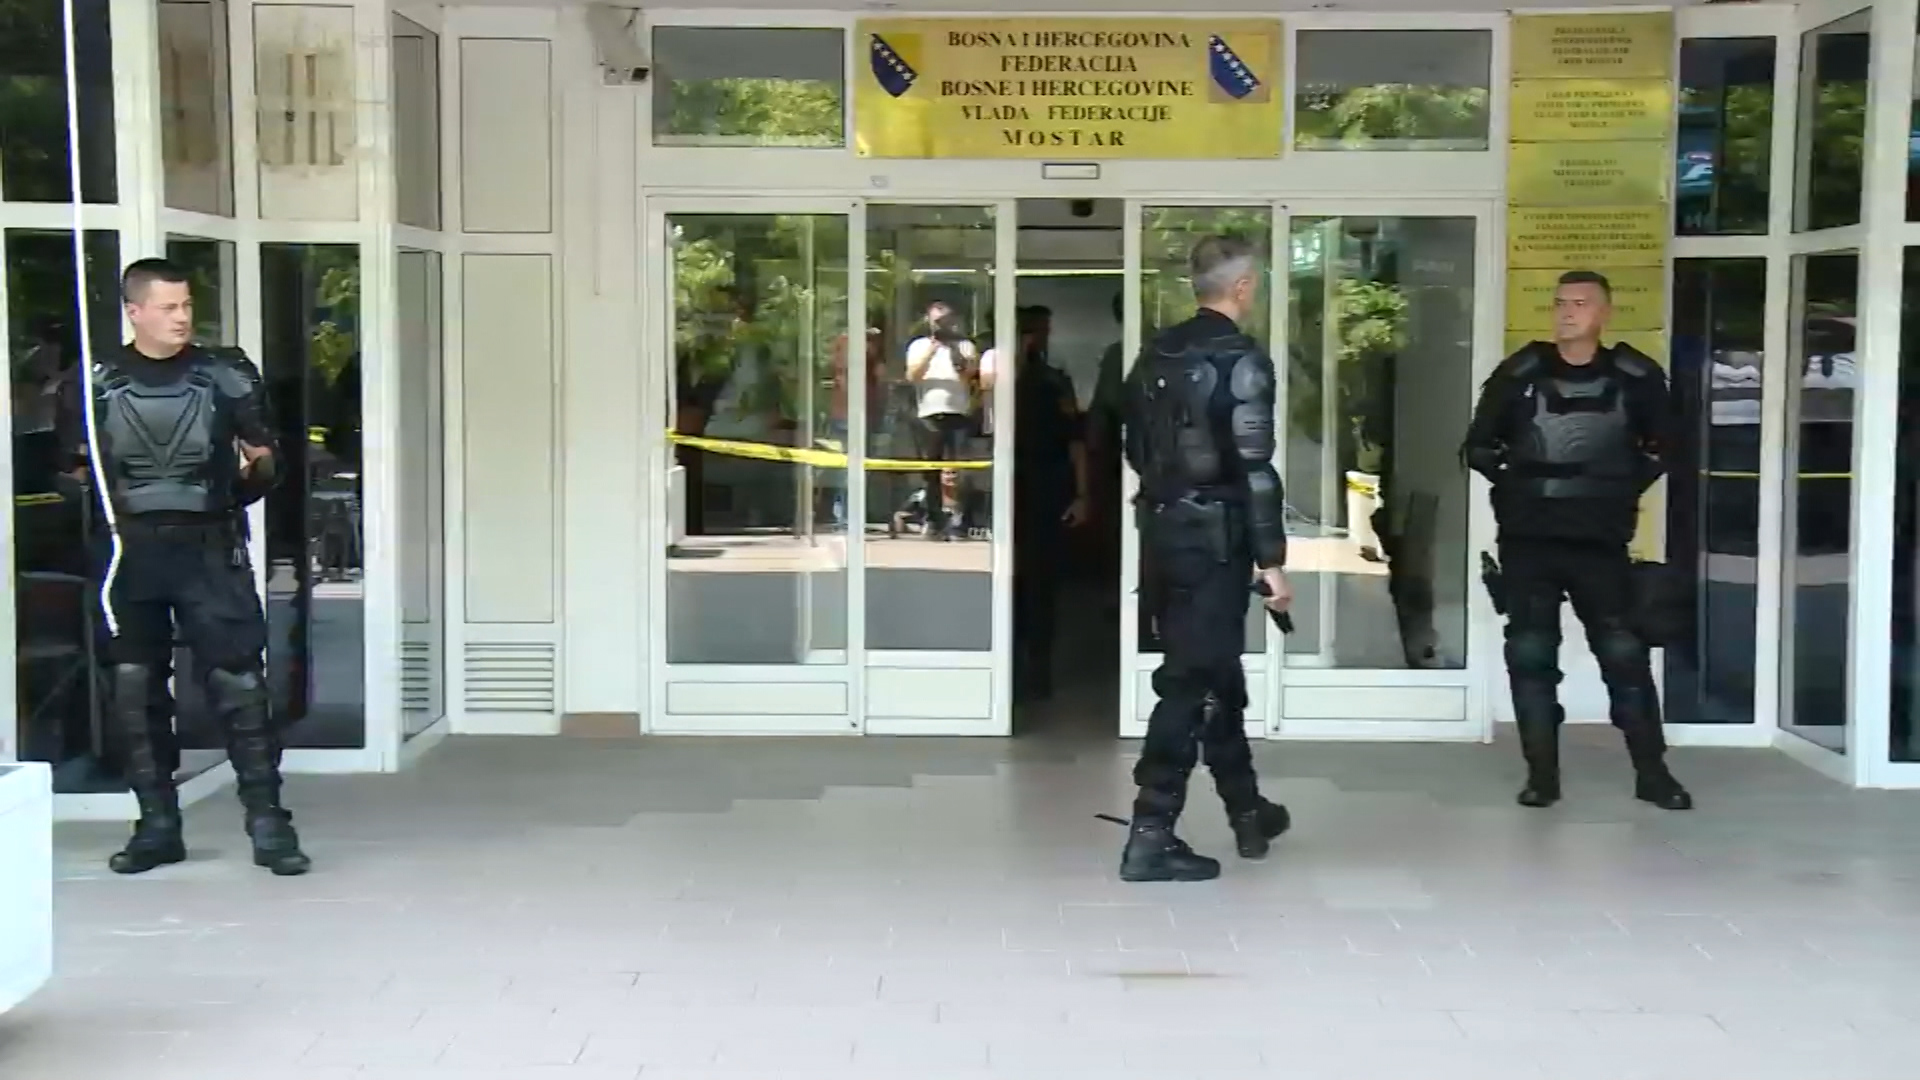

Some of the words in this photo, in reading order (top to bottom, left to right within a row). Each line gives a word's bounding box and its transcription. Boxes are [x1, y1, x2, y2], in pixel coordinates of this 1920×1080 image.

[947, 32, 1016, 47] BOSNA
[1022, 32, 1030, 47] I
[1034, 32, 1192, 47] HERCEGOVINA
[1001, 55, 1137, 72] FEDERACIJA
[941, 80, 1012, 96] BOSNE
[1016, 80, 1026, 96] I
[1032, 80, 1194, 96] HERCEGOVINE
[962, 105, 1030, 120] VLADA
[1048, 105, 1172, 121] FEDERACIJE
[1002, 130, 1125, 146] MOSTAR
